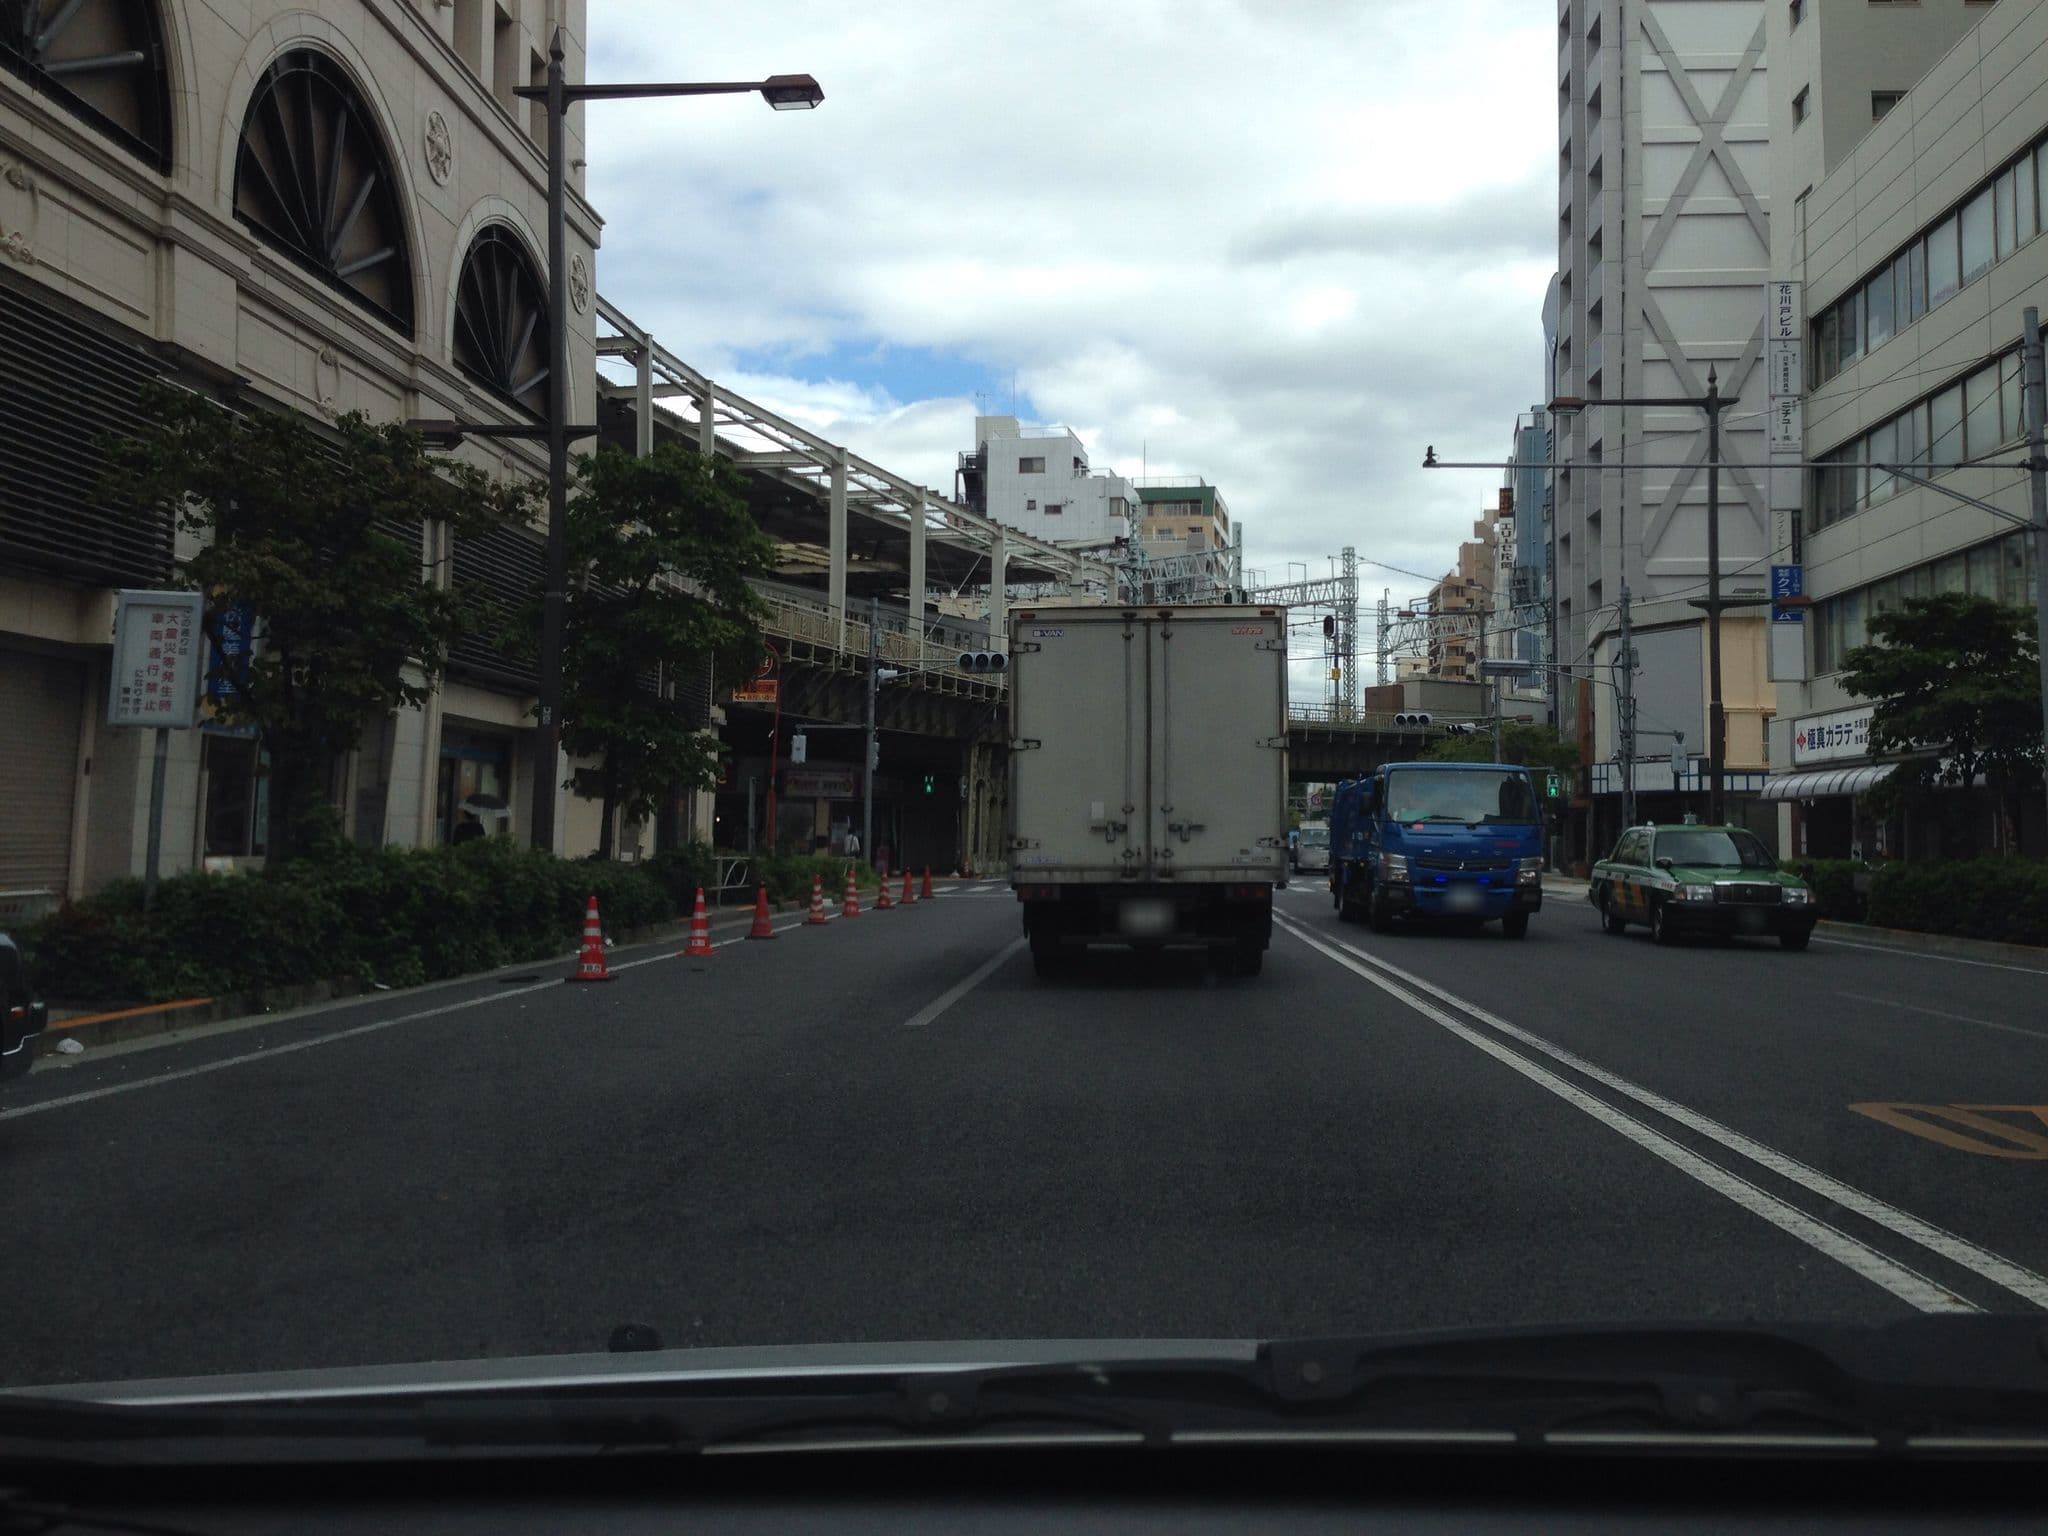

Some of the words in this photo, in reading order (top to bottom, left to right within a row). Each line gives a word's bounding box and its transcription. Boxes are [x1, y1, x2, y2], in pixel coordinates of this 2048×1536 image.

[1779, 284, 1792, 337] 花川戸ビル
[145, 613, 164, 712] 車両通行禁止
[158, 613, 179, 711] 大震災等発生時
[132, 670, 144, 714] になります
[1807, 722, 1853, 751] 極真カラテ
